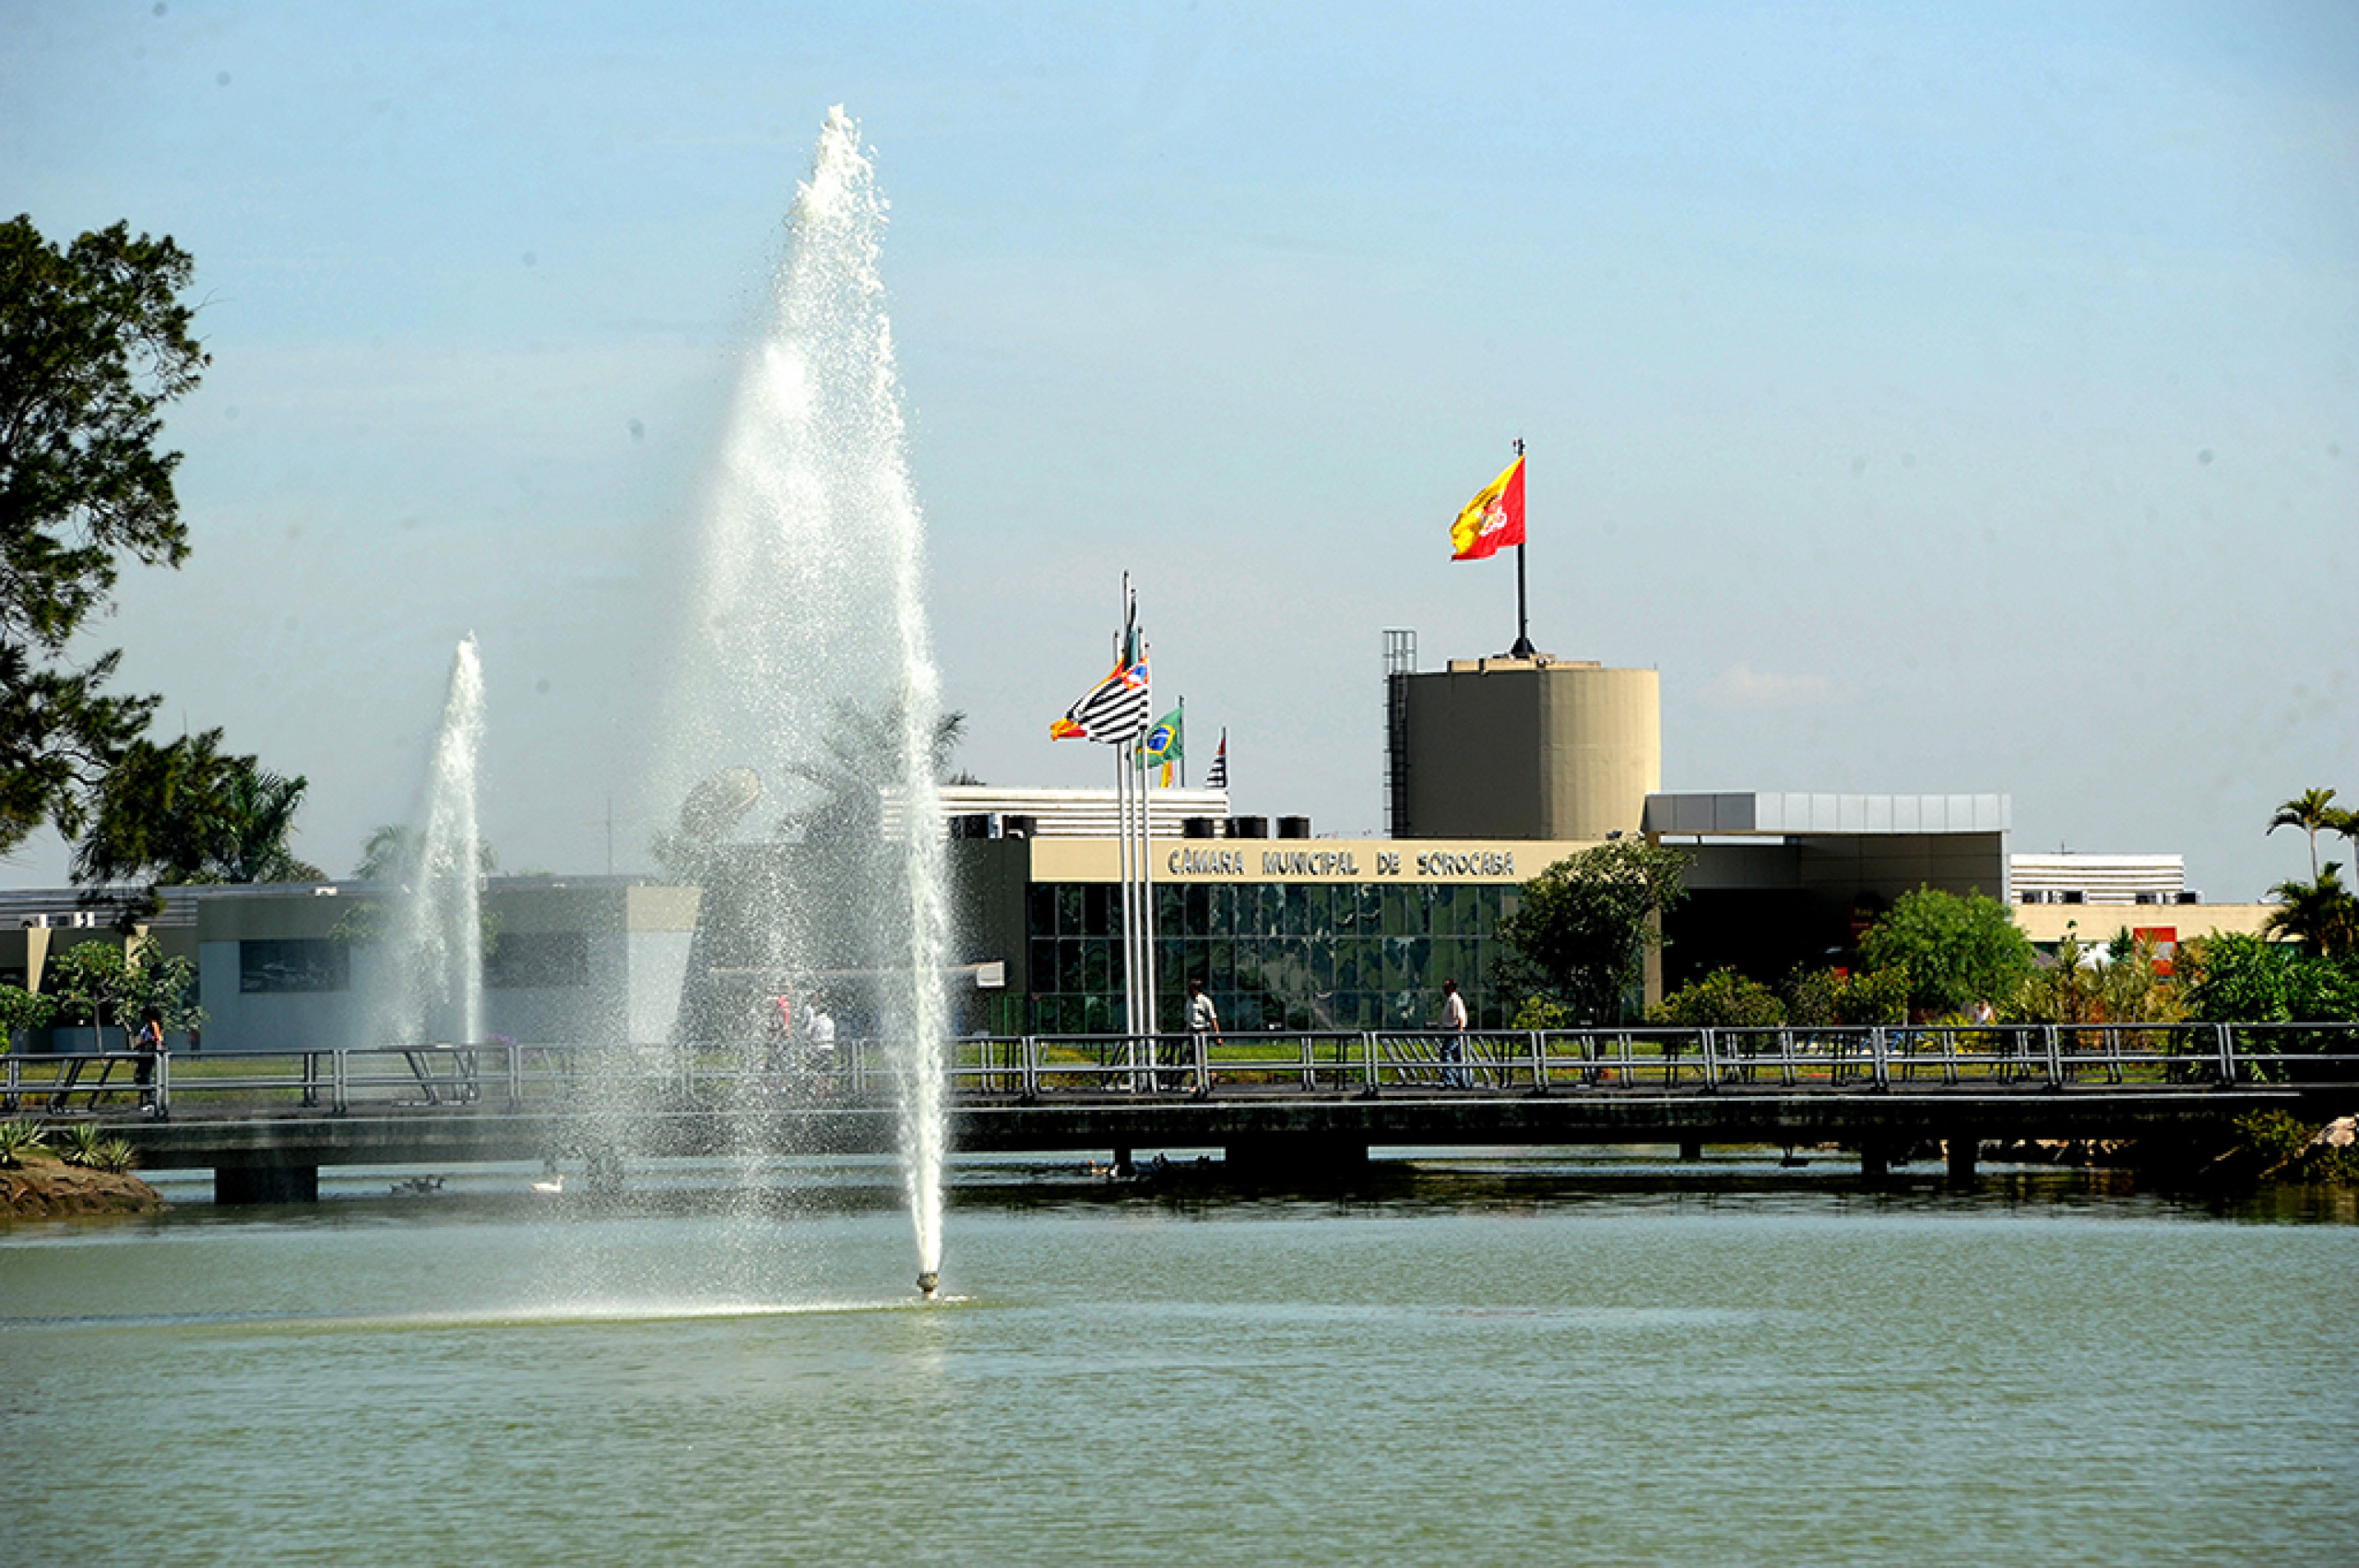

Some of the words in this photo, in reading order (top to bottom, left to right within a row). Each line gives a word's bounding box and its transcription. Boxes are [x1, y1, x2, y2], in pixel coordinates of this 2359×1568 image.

[1262, 851, 1359, 875] MUNICIPAL
[1377, 851, 1401, 875] DE
[1416, 851, 1514, 875] SOROCABA
